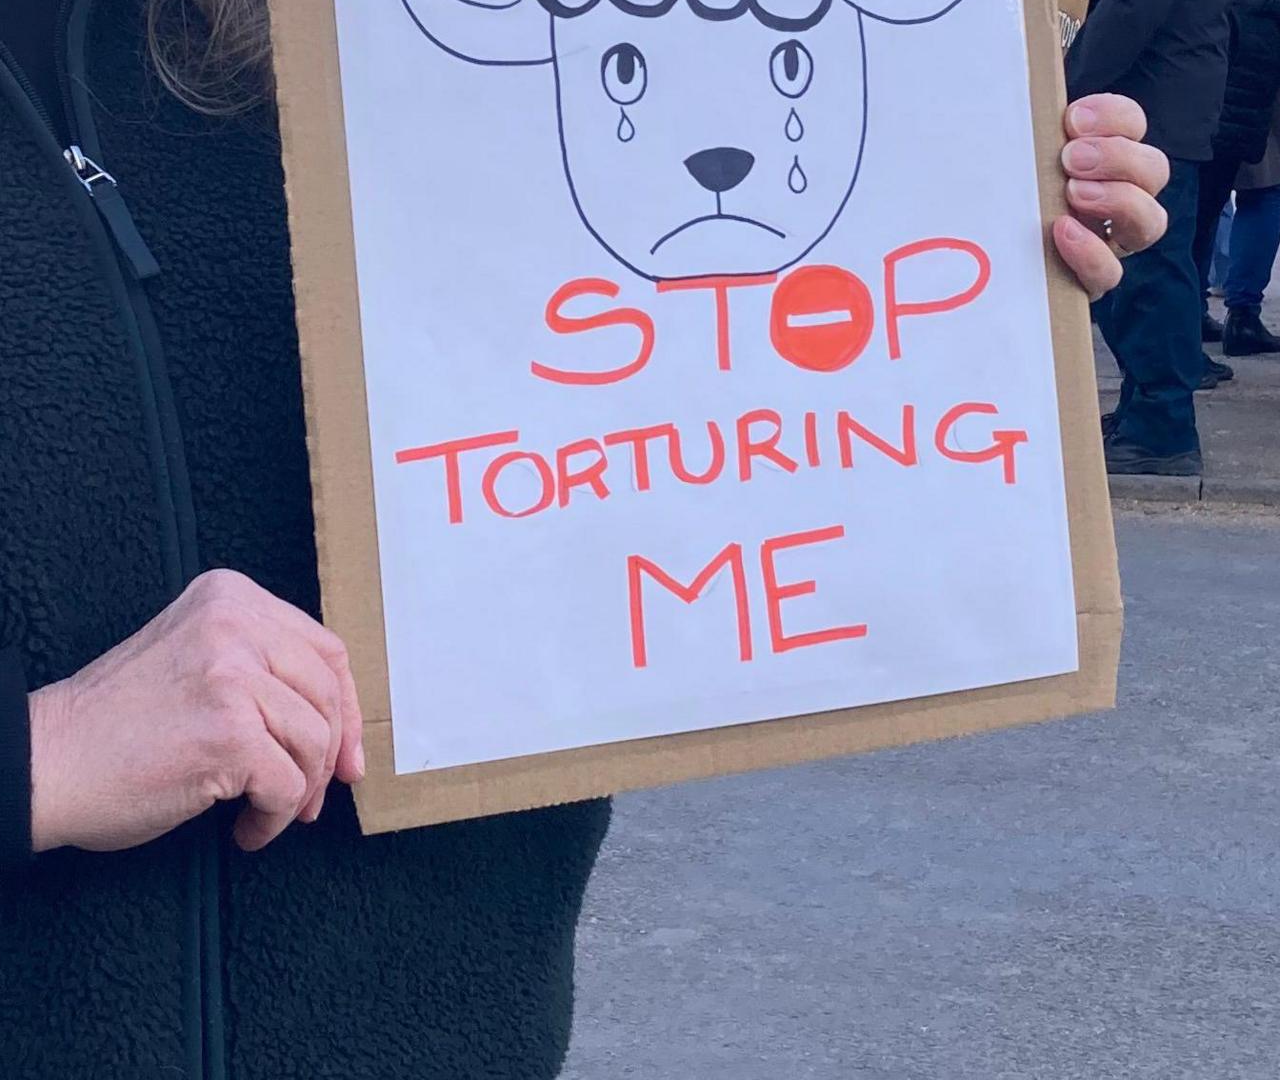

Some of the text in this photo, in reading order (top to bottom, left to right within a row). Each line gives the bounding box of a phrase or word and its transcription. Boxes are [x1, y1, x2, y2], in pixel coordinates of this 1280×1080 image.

[531, 237, 991, 386] STOP
[395, 402, 1029, 525] TORTURING
[627, 525, 867, 668] ME
